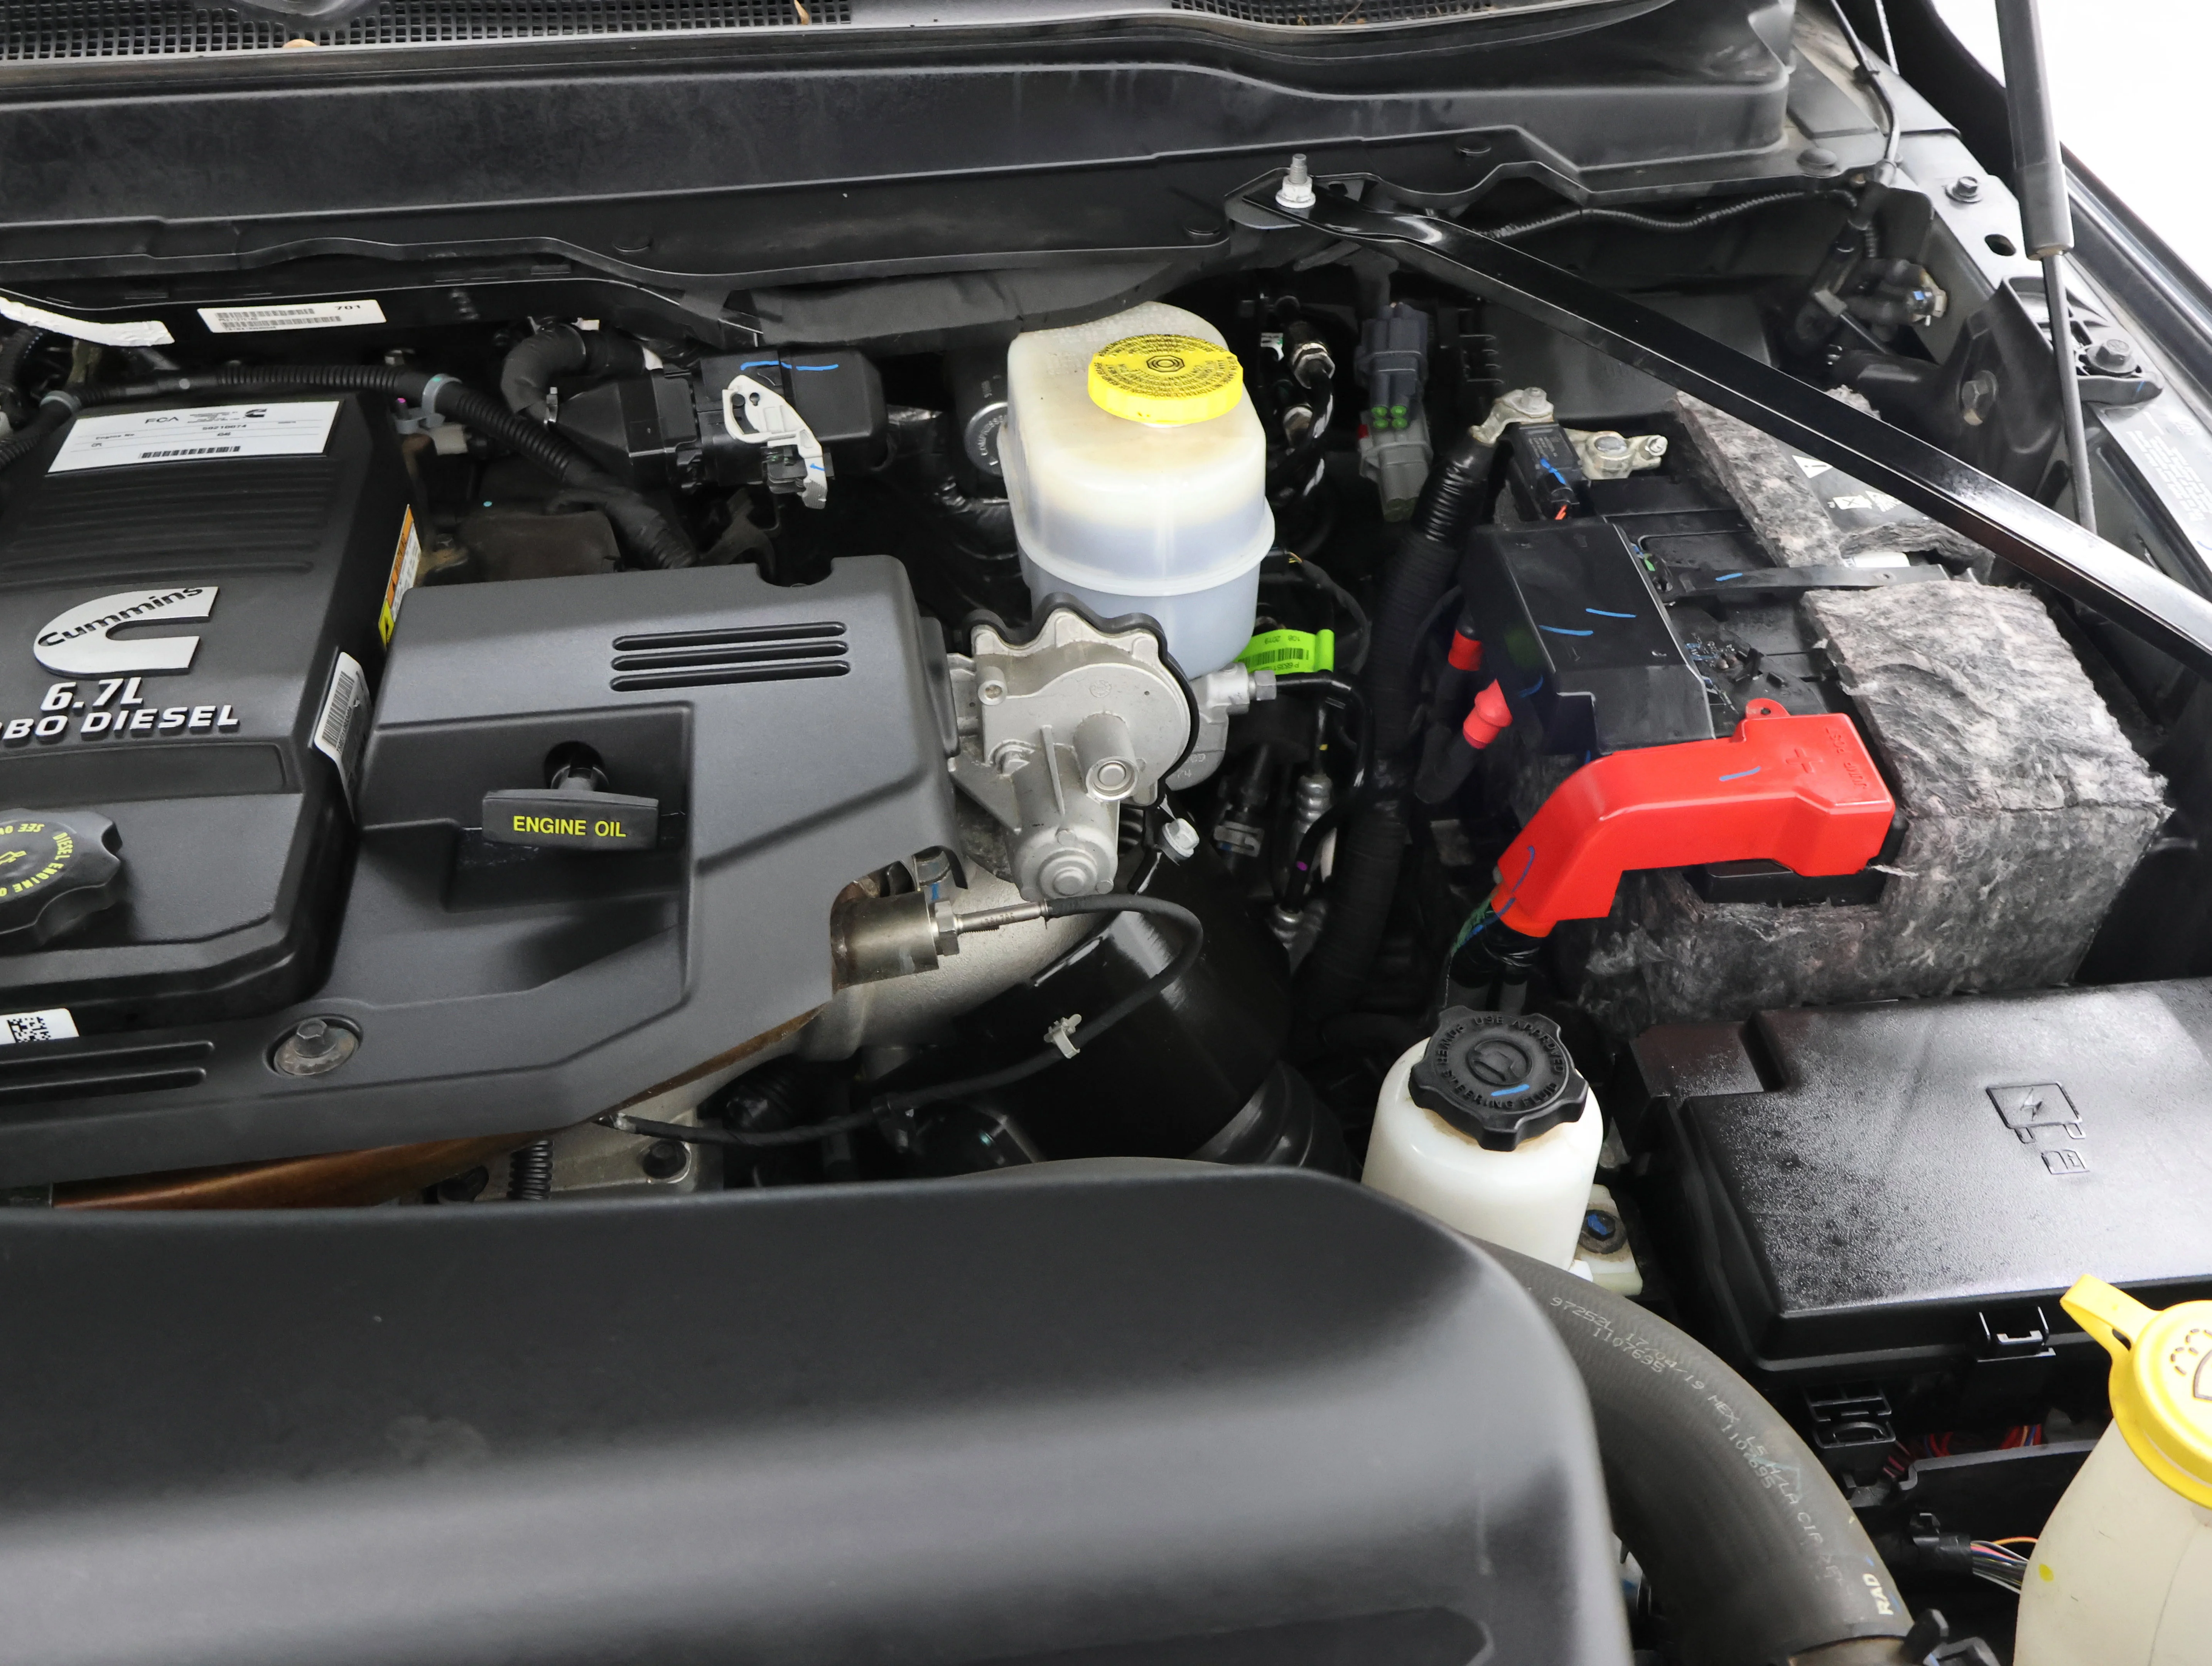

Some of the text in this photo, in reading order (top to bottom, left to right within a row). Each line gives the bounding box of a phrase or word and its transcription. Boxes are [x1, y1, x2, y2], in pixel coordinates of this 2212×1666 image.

[1184, 383, 1225, 397] NETTOYER
[39, 587, 203, 646] Cummins
[40, 677, 143, 712] 6.7L
[80, 705, 239, 734] DIESEL
[17, 823, 45, 832] SEE
[513, 815, 627, 837] ENGINE OIL
[12, 832, 73, 893] DIESEL ENGINE
[1474, 1015, 1565, 1073] USE APPROVED
[1443, 1069, 1513, 1108] STEERING
[1550, 1297, 1614, 1333] 97252L
[1708, 1394, 1741, 1423] MEX
[1863, 1572, 1894, 1616] RAD
